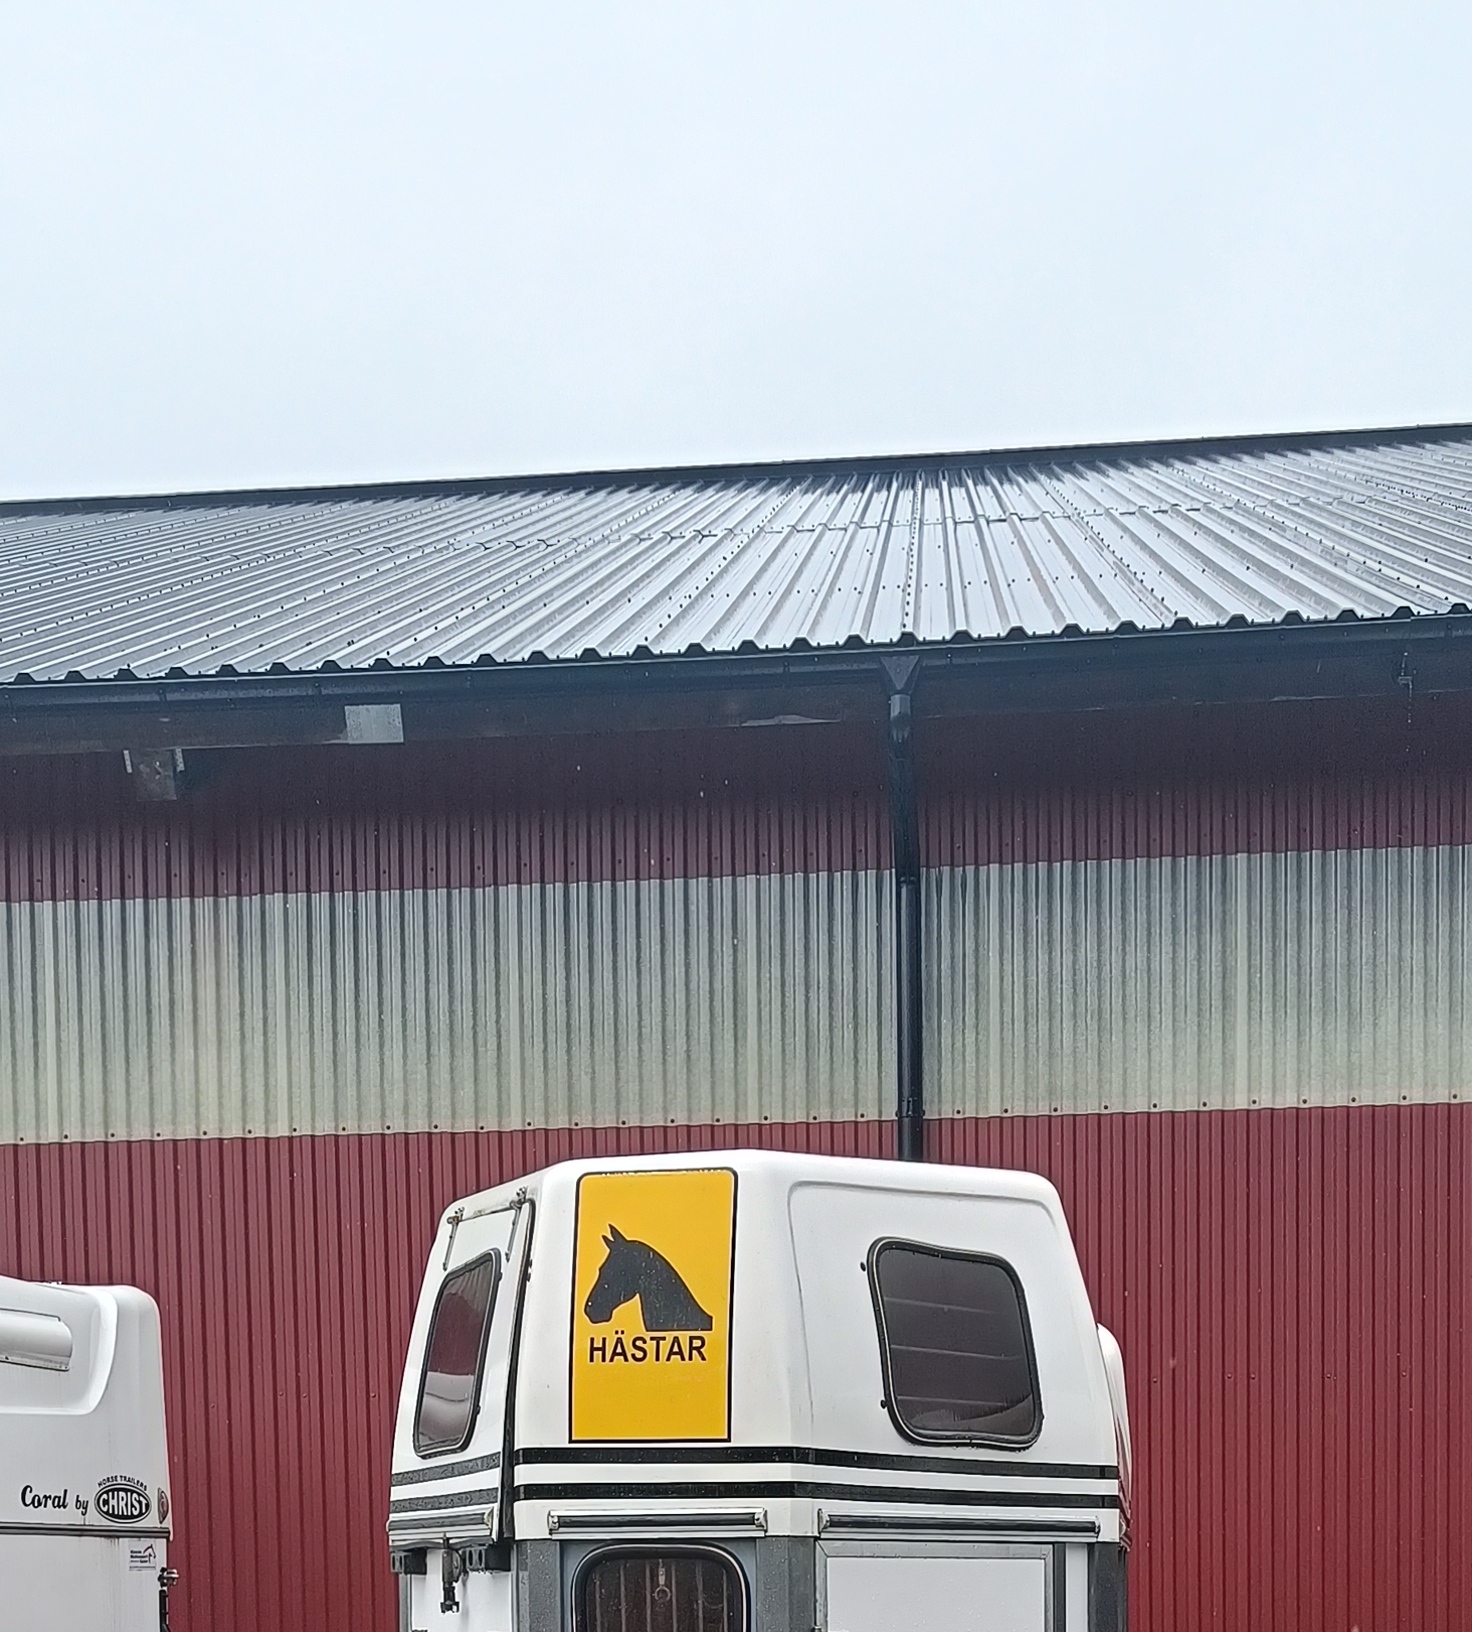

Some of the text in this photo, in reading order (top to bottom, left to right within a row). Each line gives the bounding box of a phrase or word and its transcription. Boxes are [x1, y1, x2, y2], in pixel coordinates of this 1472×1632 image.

[589, 1330, 707, 1363] HÄSTAR
[98, 1475, 147, 1491] HORSE TRAILERS
[21, 1485, 148, 1516] Coral by CHRIST
